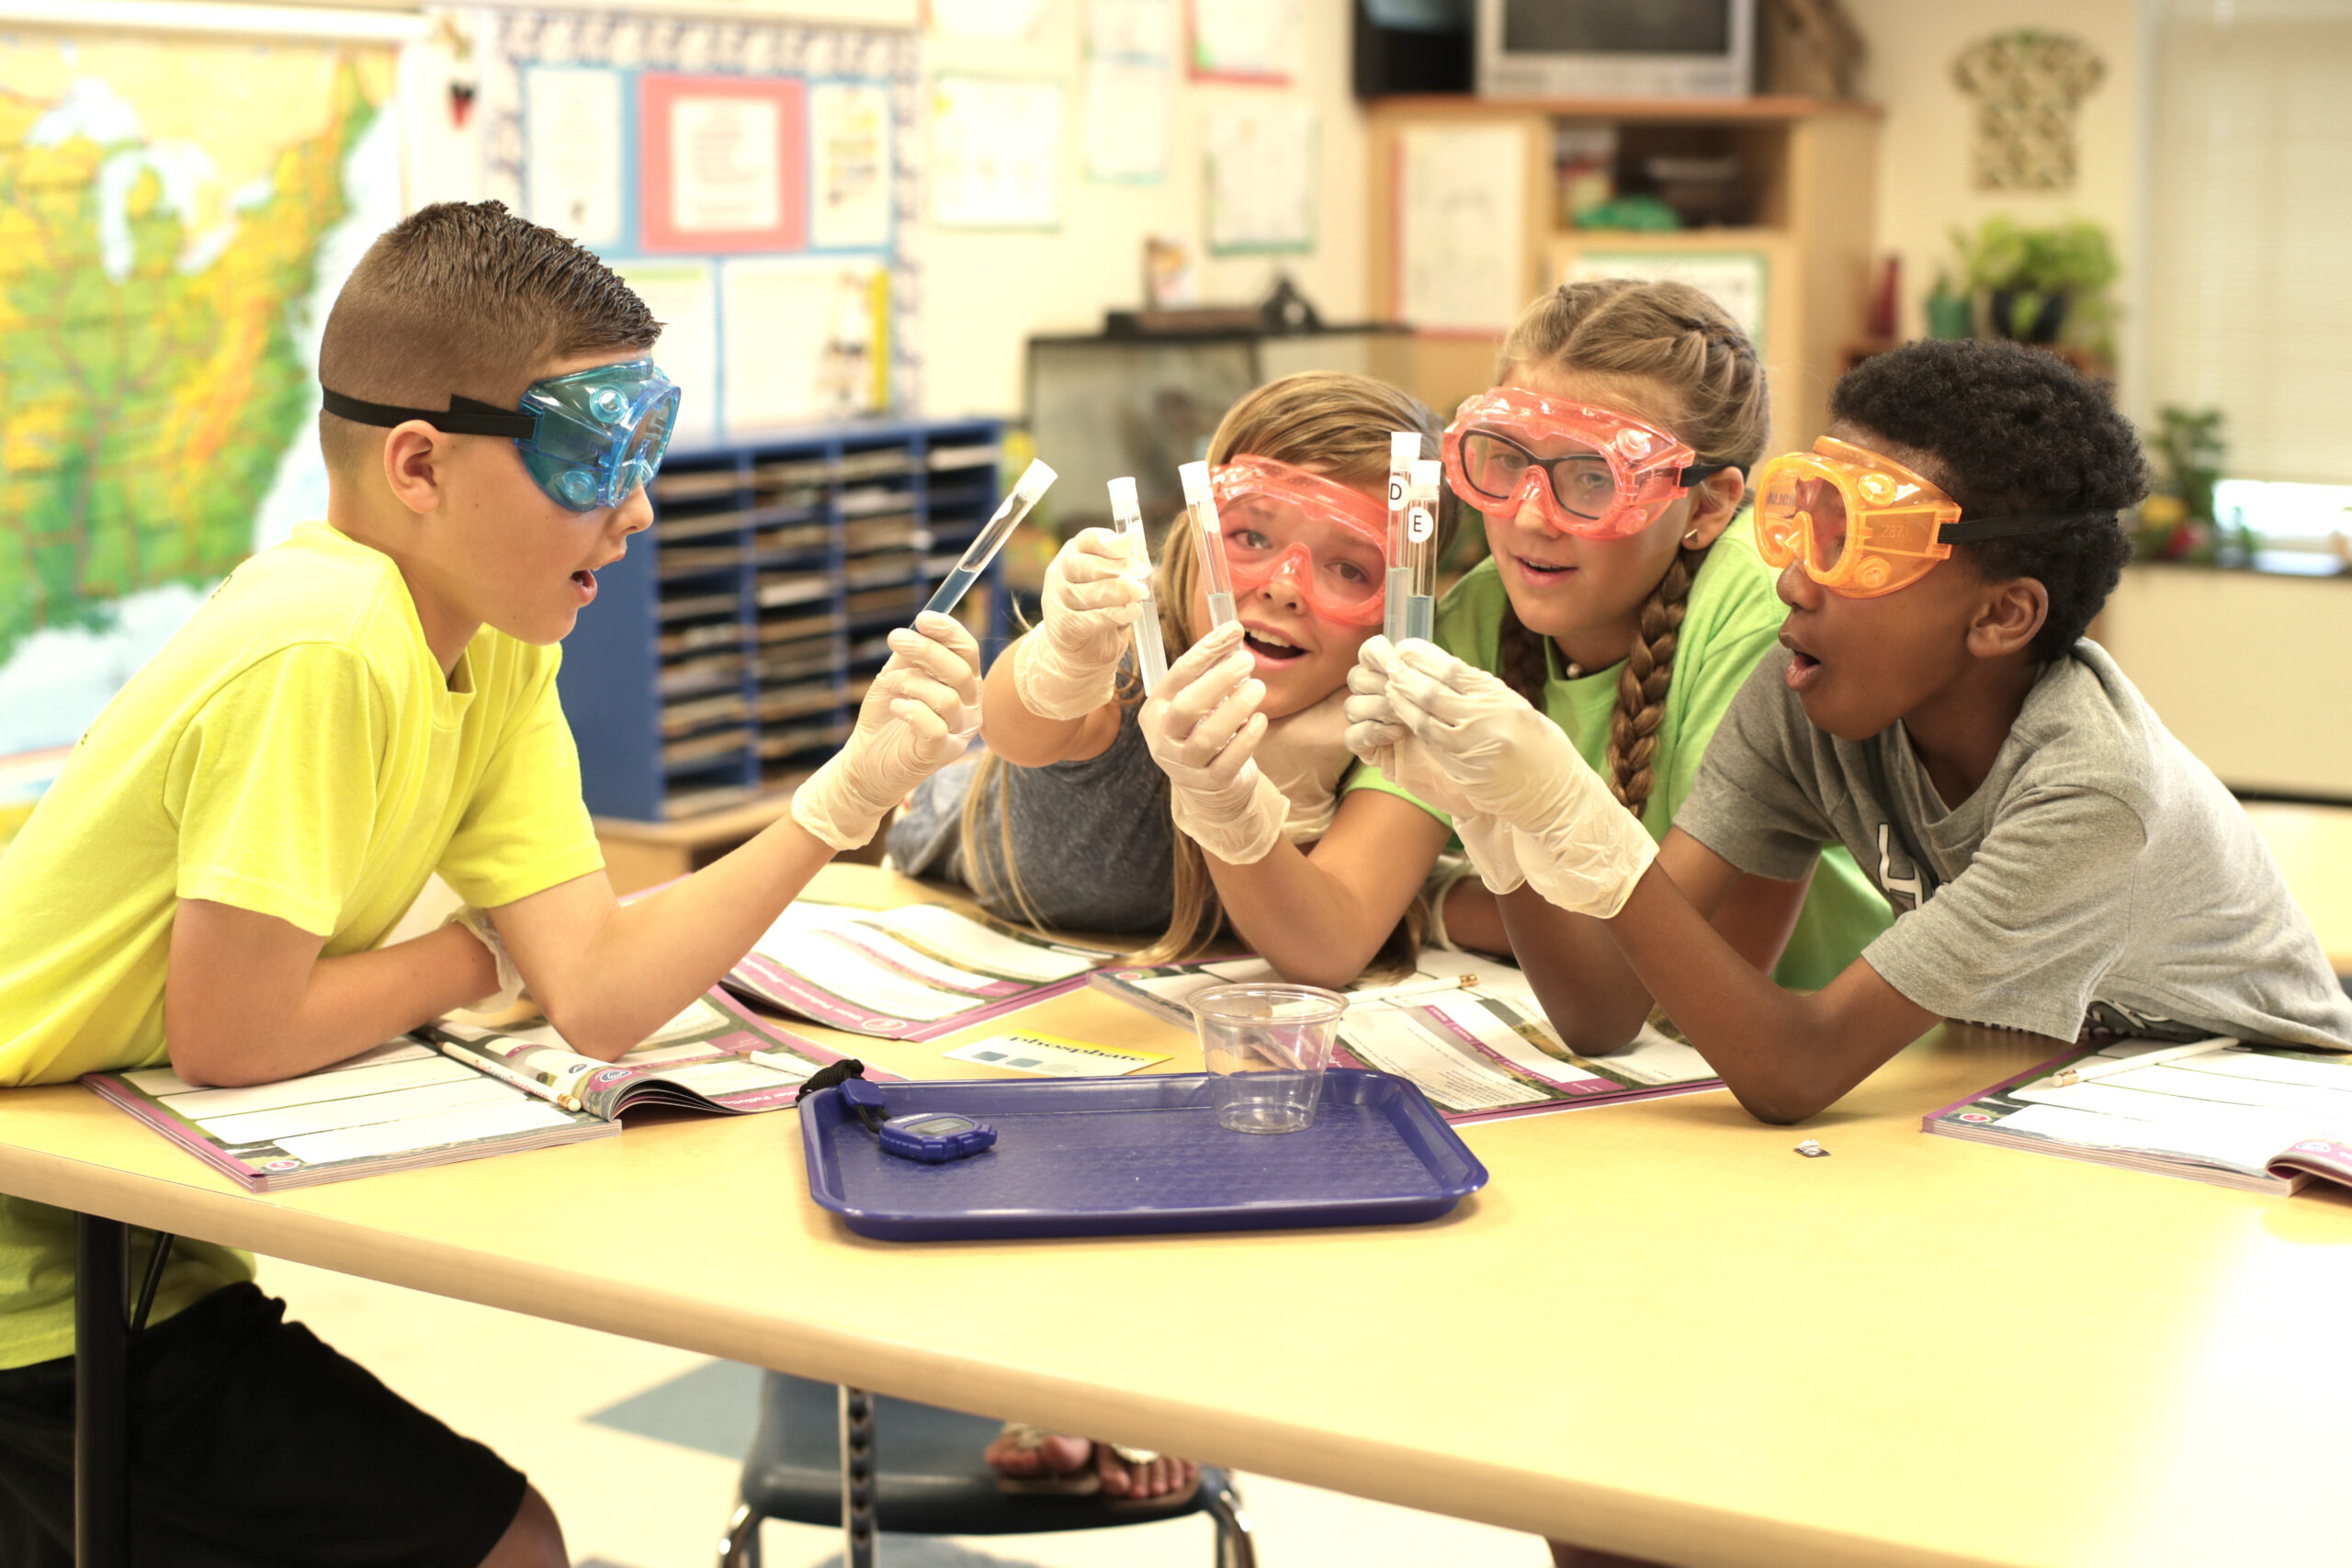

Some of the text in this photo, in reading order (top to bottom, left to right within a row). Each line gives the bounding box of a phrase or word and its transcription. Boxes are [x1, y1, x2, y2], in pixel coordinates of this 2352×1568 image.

[1389, 482, 1402, 501] D
[1413, 514, 1423, 533] E
[1009, 1035, 1146, 1062] phosphate
